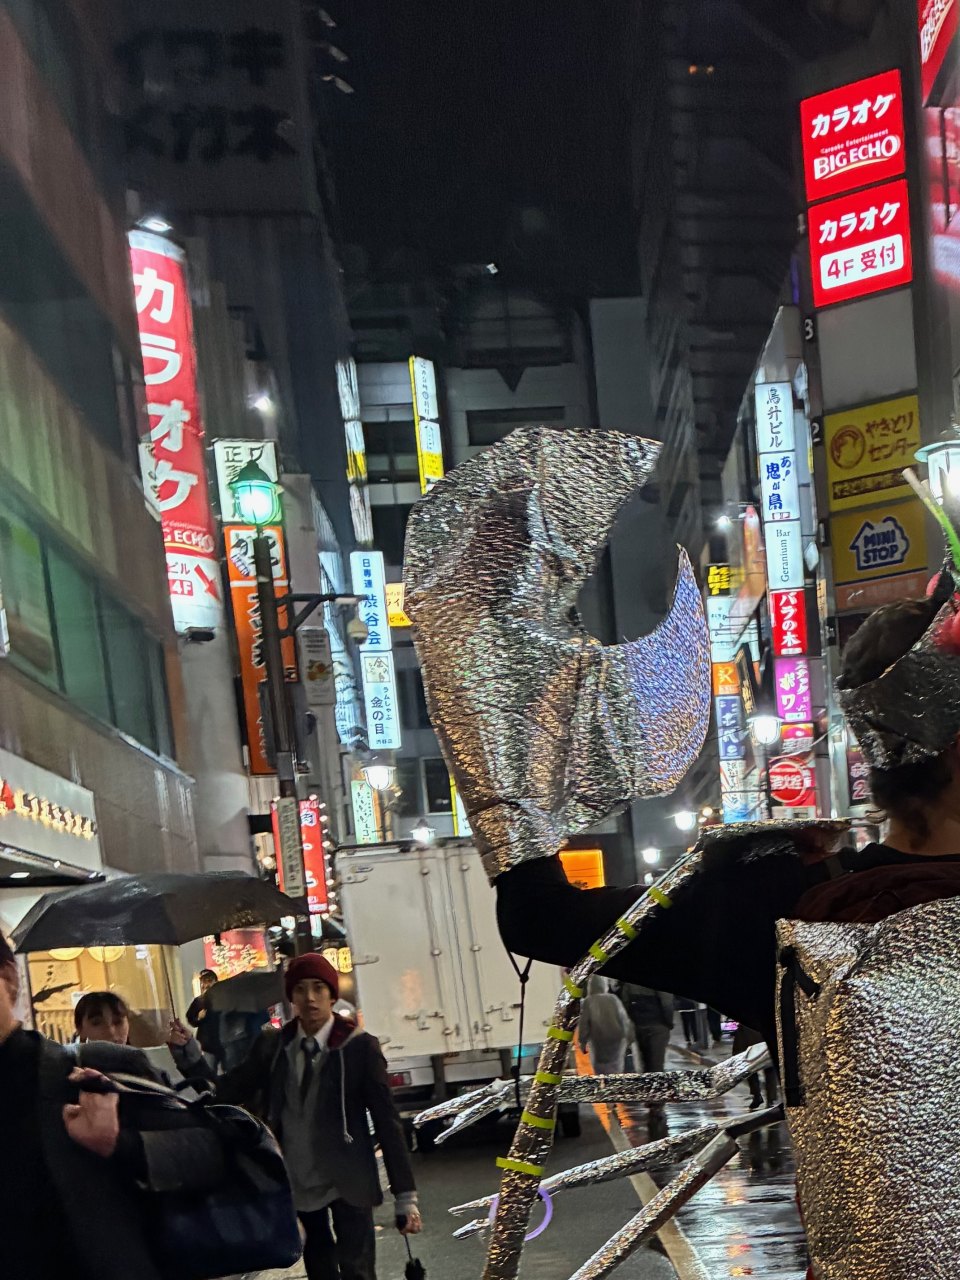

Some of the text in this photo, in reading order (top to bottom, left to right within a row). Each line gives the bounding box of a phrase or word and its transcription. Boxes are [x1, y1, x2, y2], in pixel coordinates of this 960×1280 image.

[811, 93, 897, 139] カラオケ
[813, 135, 901, 180] BIG ECHO
[819, 202, 901, 244] カラオケ
[827, 243, 896, 279] 4F 受付
[132, 267, 199, 512] カラオケ
[173, 529, 215, 553] ECHO
[776, 529, 791, 538] Bar
[863, 529, 897, 549] MINI
[780, 539, 790, 582] Geranium
[863, 545, 899, 564] STOP
[173, 580, 192, 595] 4F
[364, 593, 382, 645] 渋谷会
[779, 592, 802, 647] バラの木
[370, 696, 385, 735] 金の目
